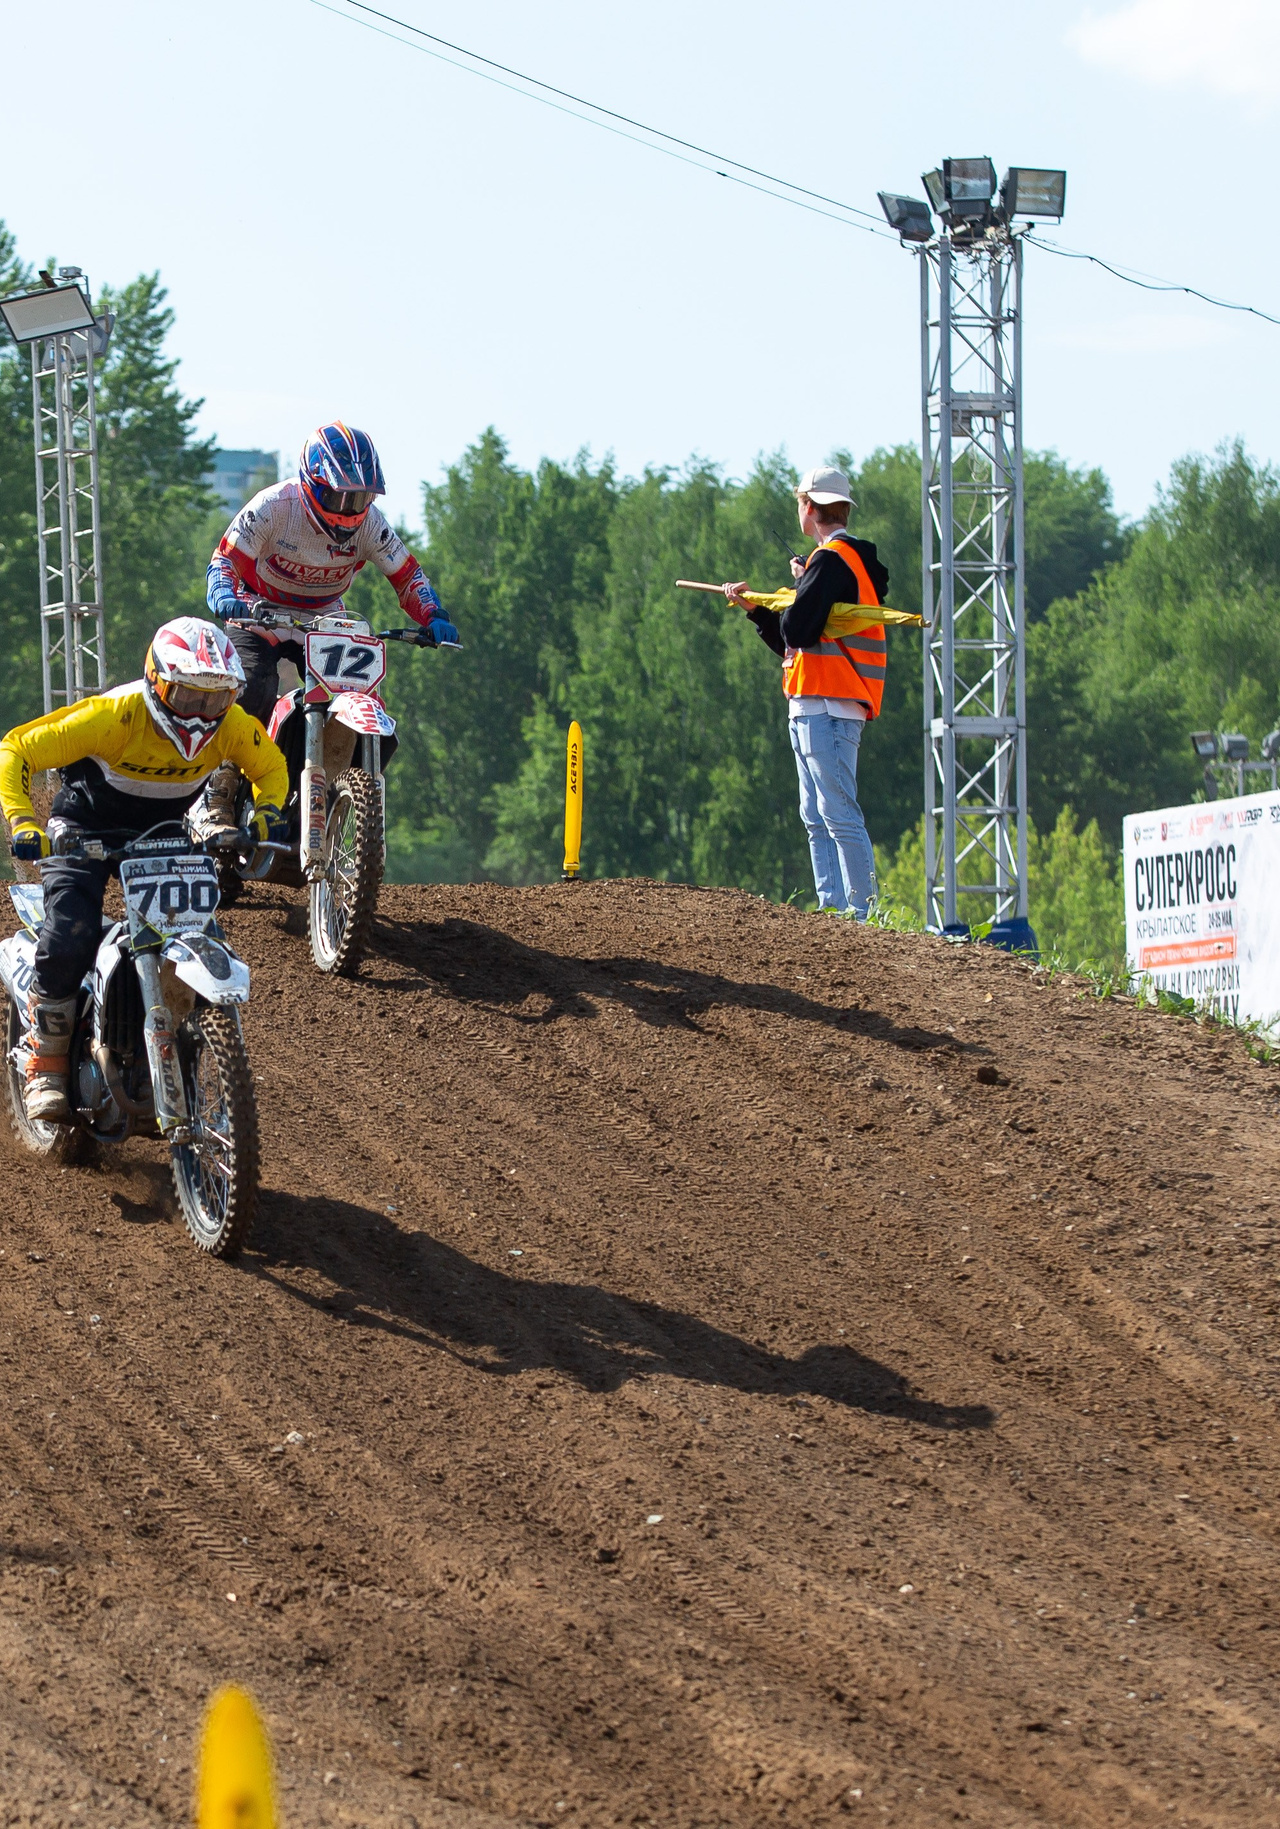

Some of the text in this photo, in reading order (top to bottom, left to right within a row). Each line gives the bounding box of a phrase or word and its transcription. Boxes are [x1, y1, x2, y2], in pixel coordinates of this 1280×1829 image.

[274, 554, 353, 579] MILYAEV
[320, 643, 376, 681] 12
[117, 761, 205, 776] SCOTT
[134, 839, 188, 850] RENTHAL
[171, 865, 209, 874] РЫЖИК
[1134, 843, 1237, 912] СУПЕРКРОСС
[128, 880, 219, 919] 700
[1135, 913, 1197, 939] КРЫЛАТСКОЕ
[1185, 964, 1240, 995] КРОССОВЫХ
